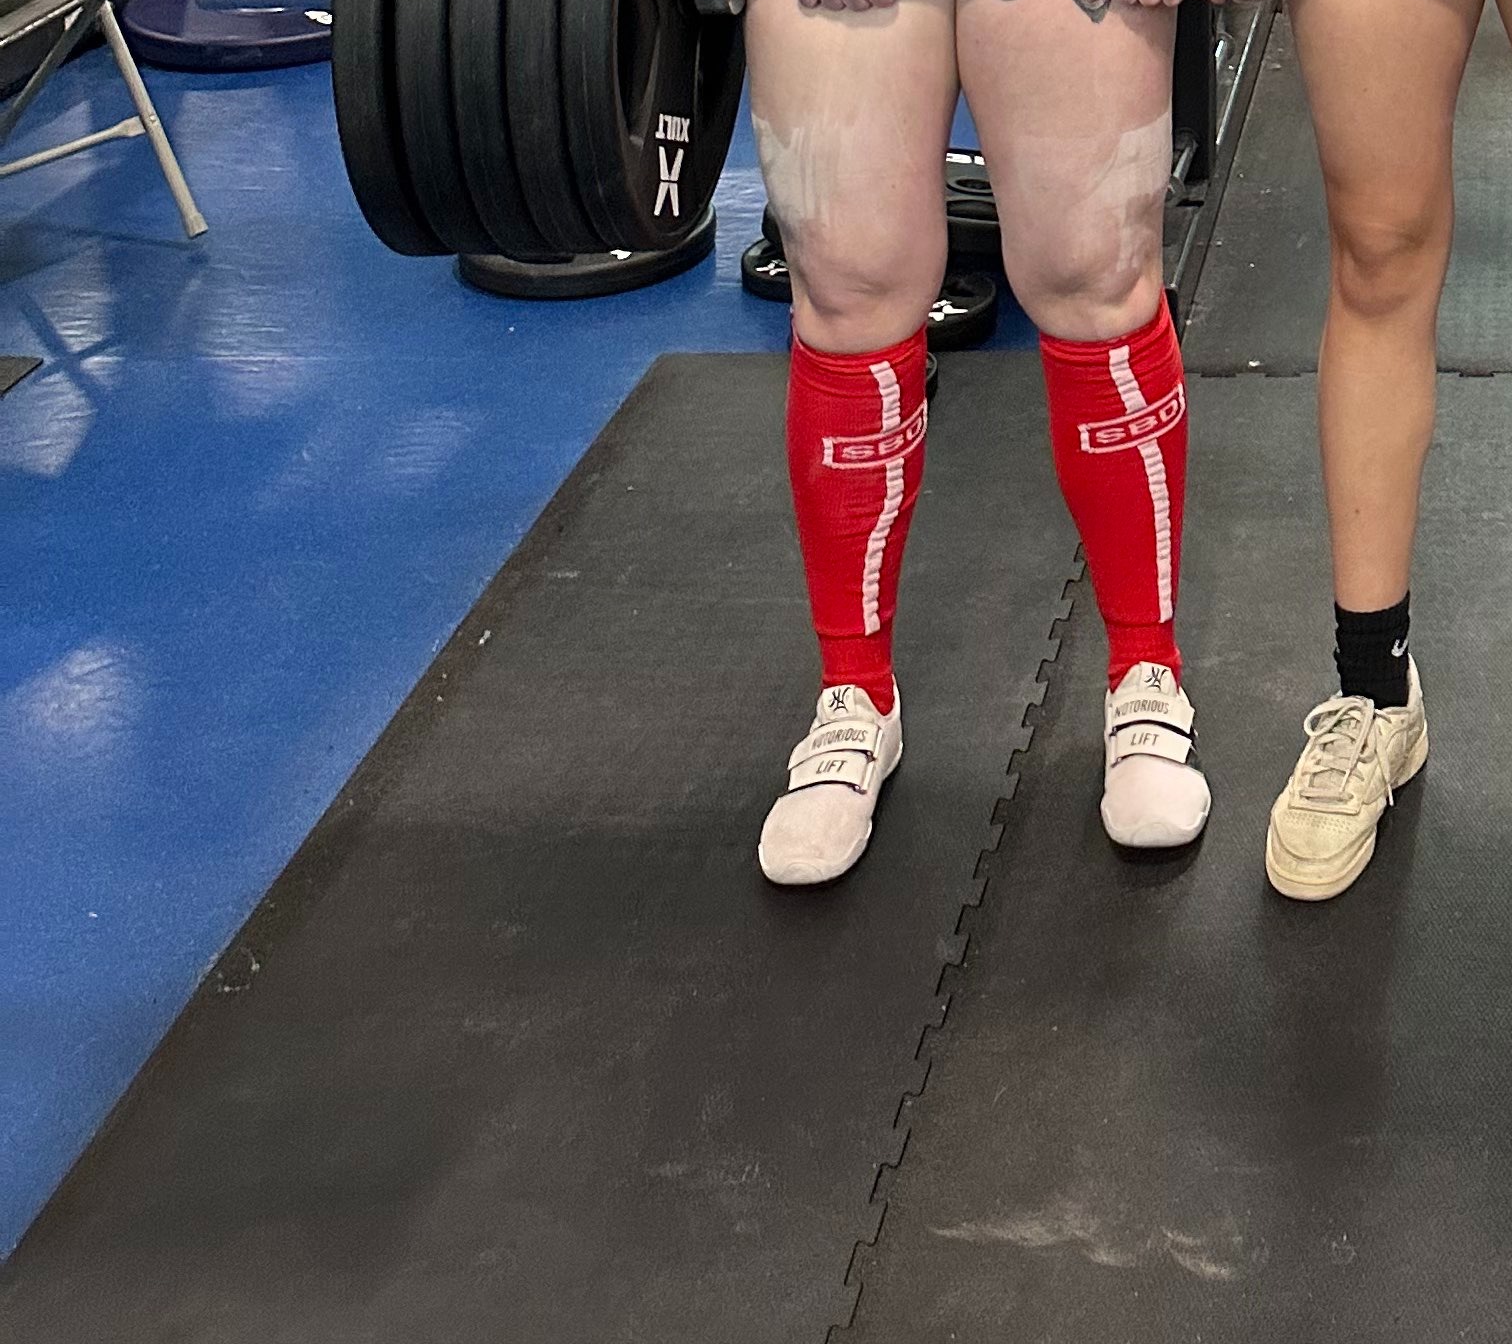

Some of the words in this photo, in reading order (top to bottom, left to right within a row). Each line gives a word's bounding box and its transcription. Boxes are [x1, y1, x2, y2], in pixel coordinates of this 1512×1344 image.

[655, 113, 690, 143] XULT
[1096, 399, 1179, 444] SBD
[842, 416, 922, 460] SBD
[1114, 699, 1170, 718] NOTORIOUS
[812, 727, 869, 750] NOTORIOUS
[1130, 732, 1160, 746] LIFT
[816, 759, 848, 774] LIFT
